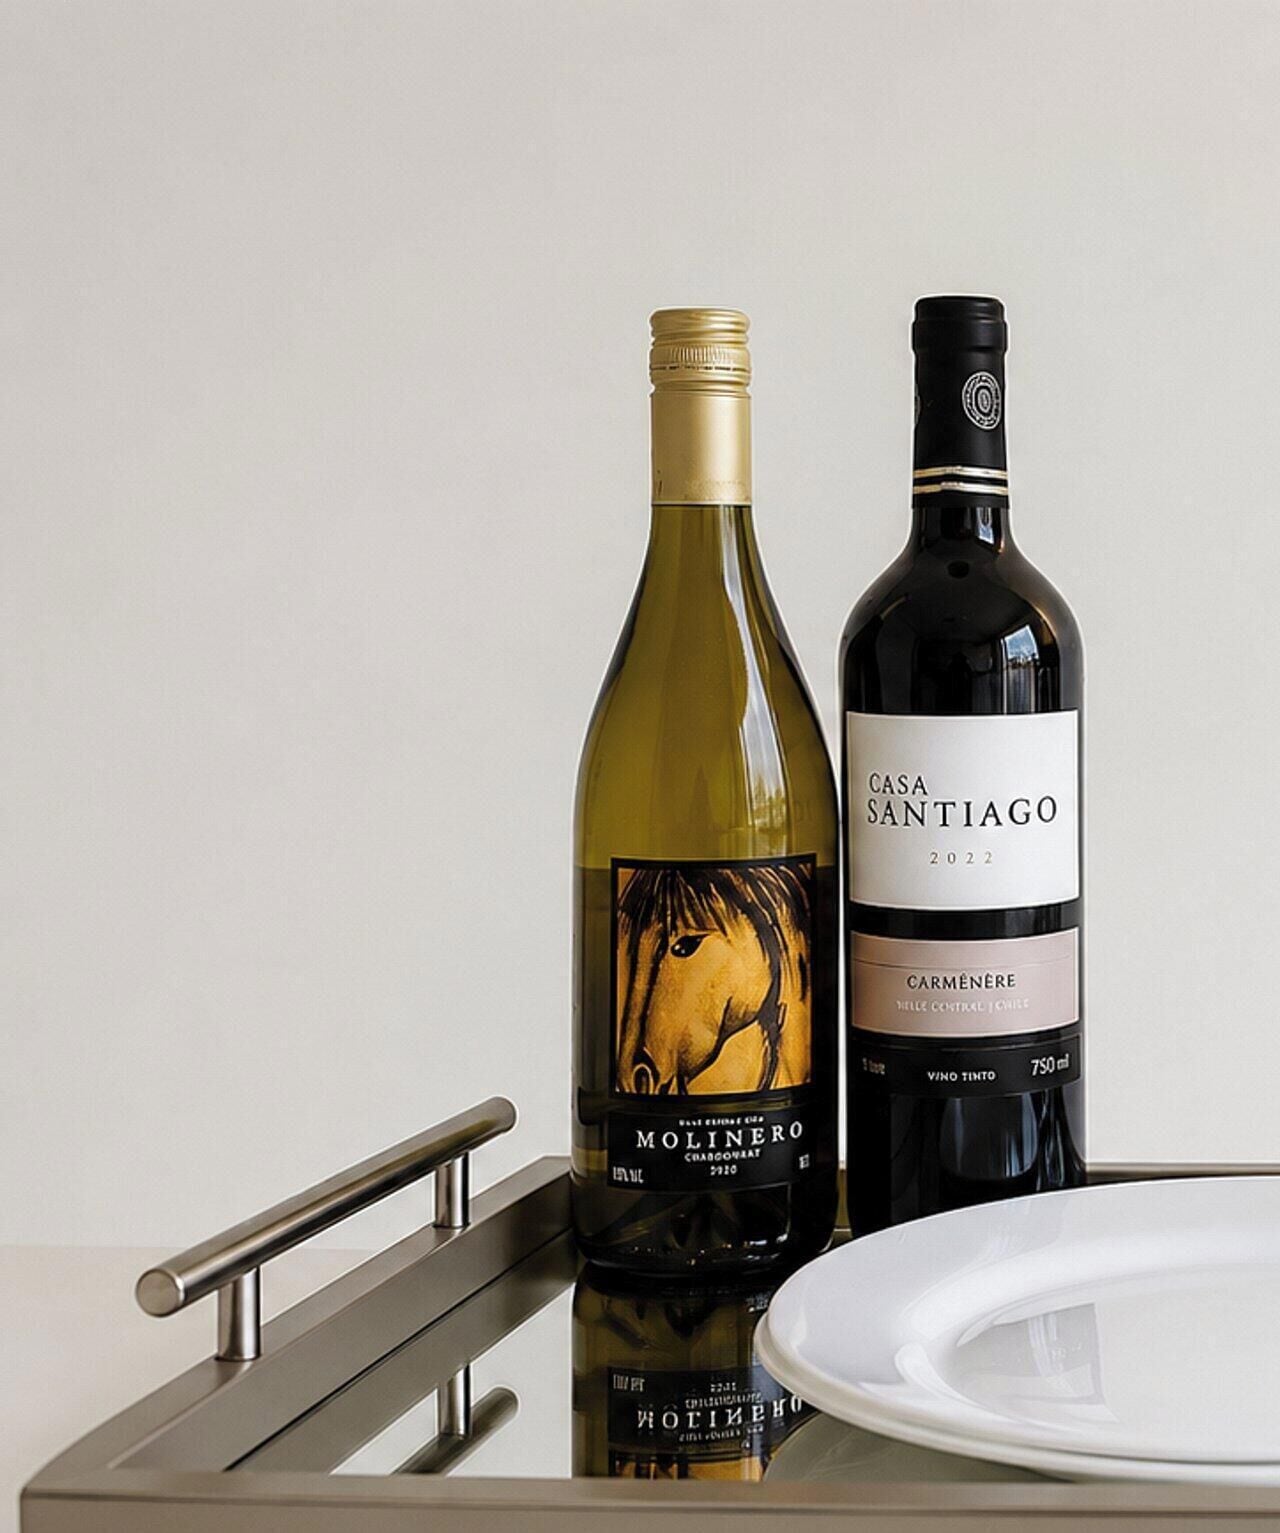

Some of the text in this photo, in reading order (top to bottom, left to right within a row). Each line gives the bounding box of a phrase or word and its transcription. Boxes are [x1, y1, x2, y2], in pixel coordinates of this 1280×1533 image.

[869, 772, 928, 796] CASA
[867, 796, 1057, 827] SANTIAGO
[929, 851, 993, 864] 2022
[927, 1070, 996, 1082] VINO TINTO
[1030, 1053, 1069, 1077] 750 ml
[636, 1121, 803, 1149] MOLINERO
